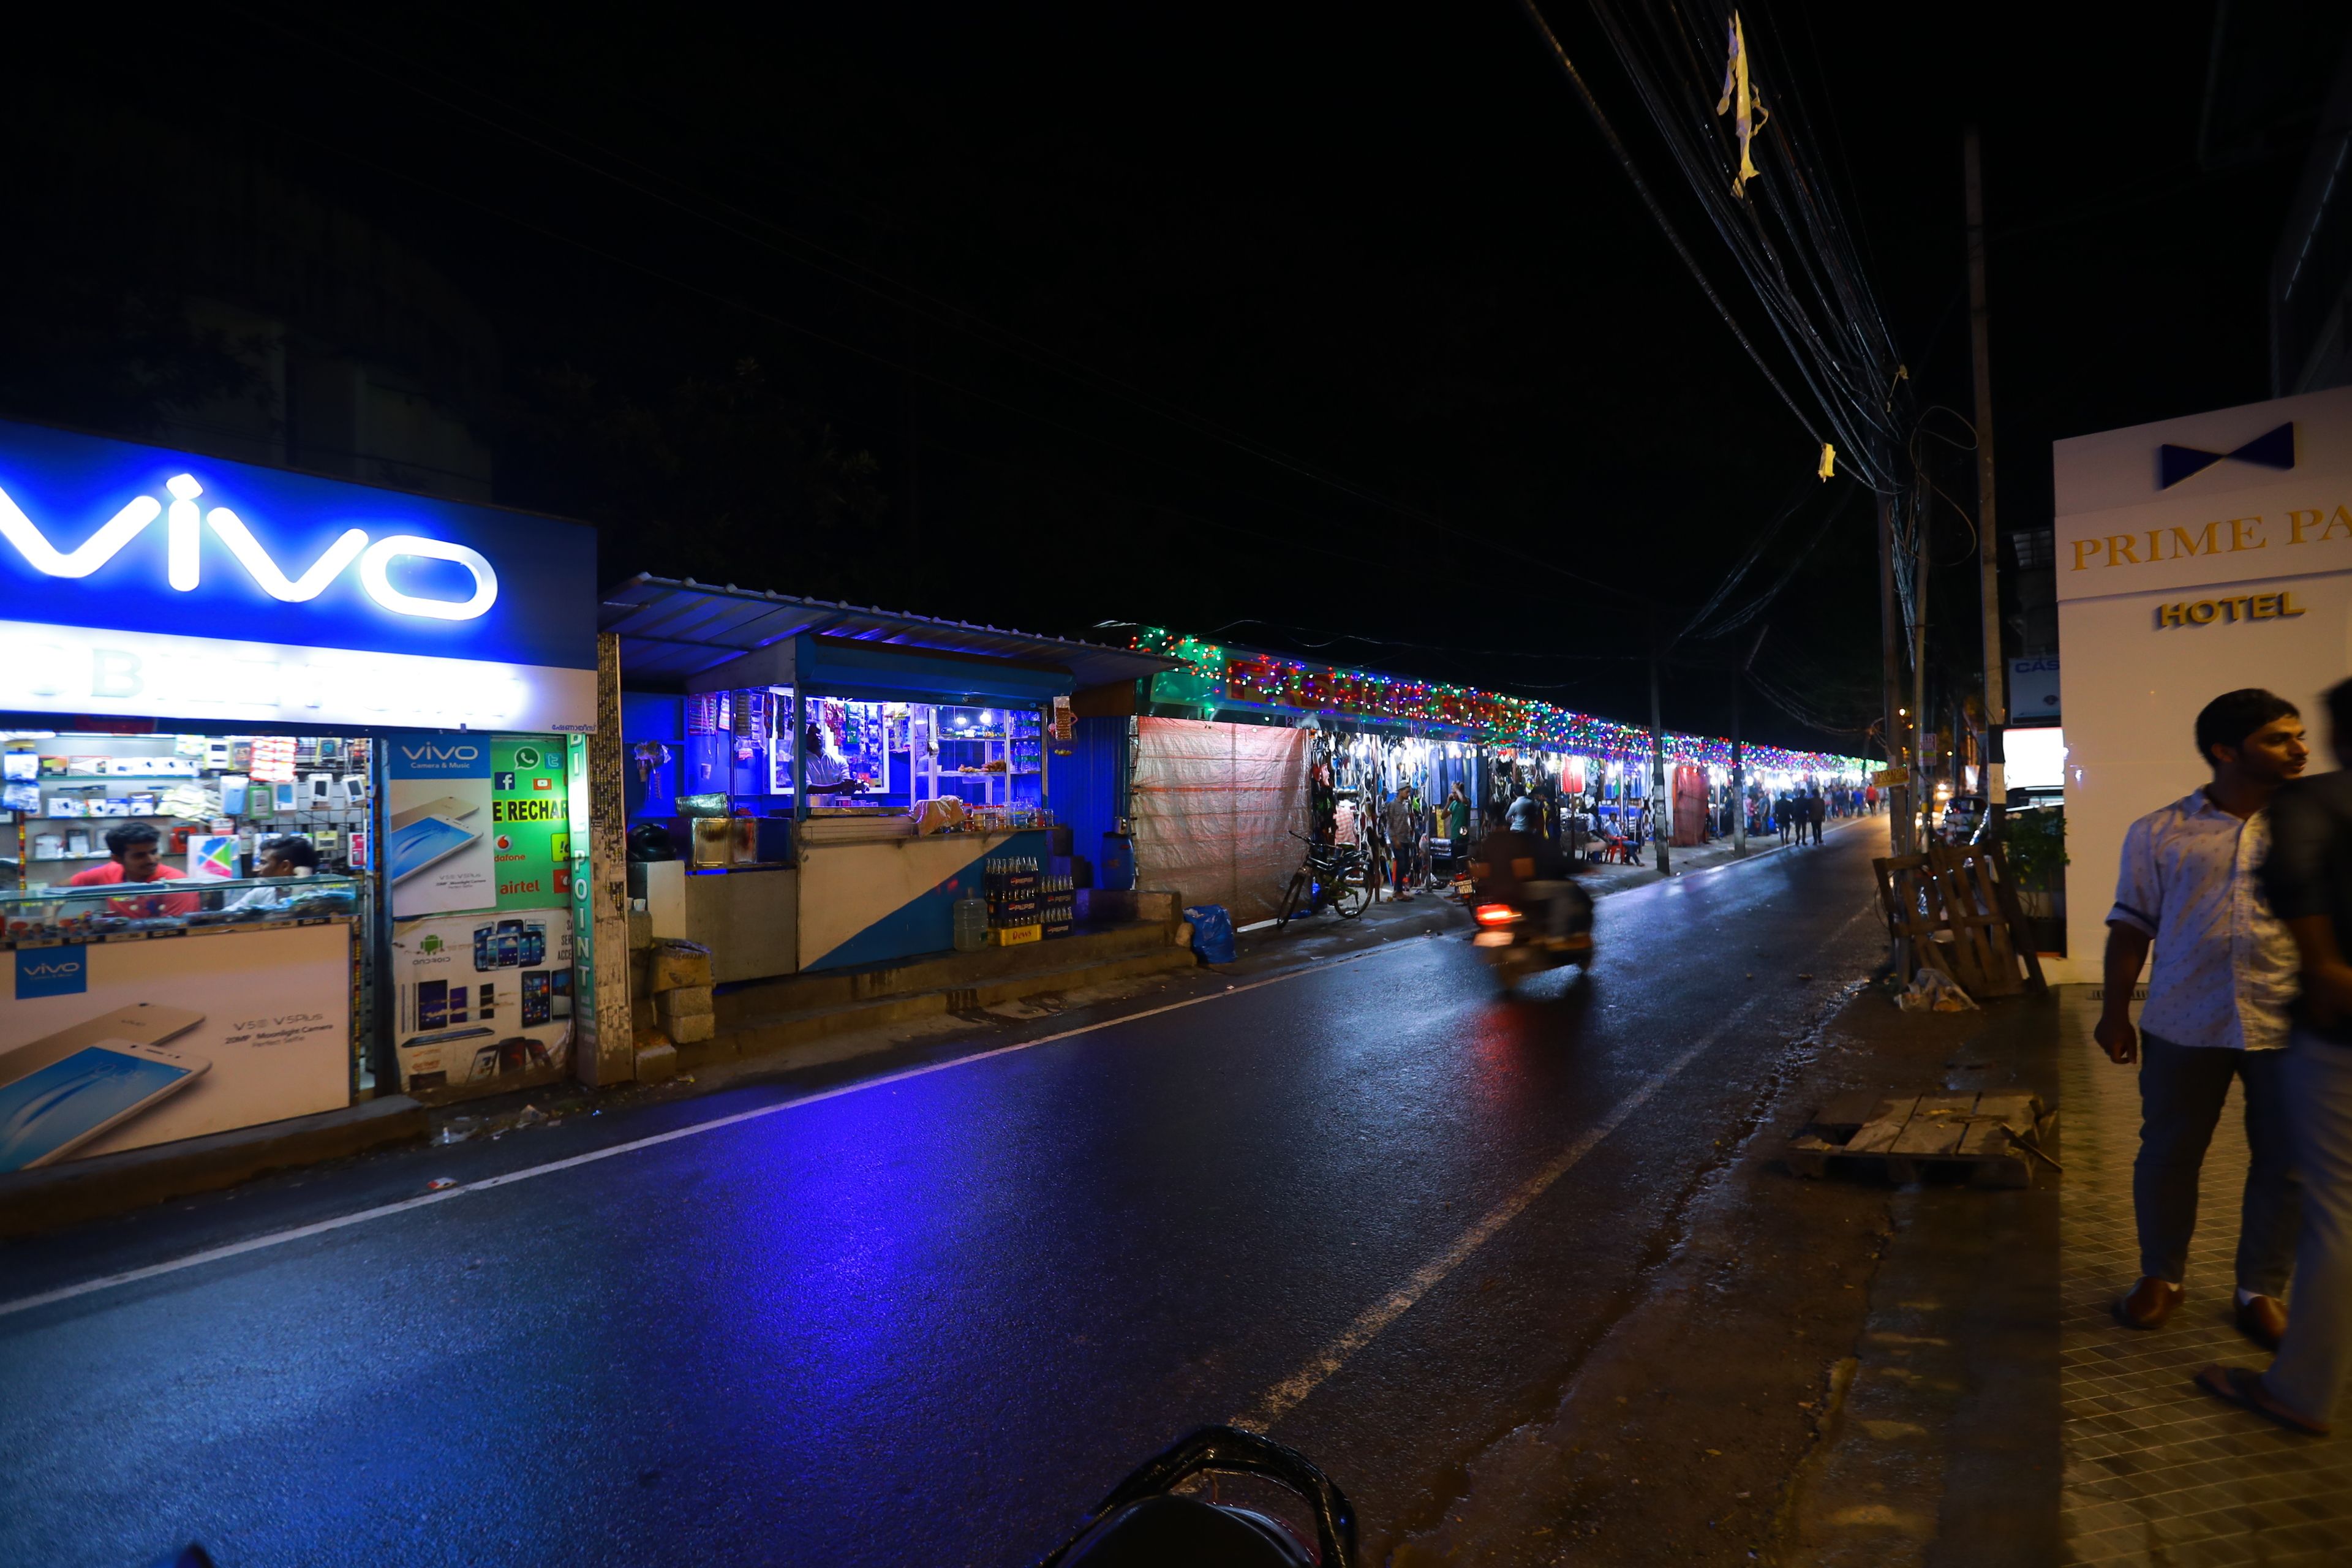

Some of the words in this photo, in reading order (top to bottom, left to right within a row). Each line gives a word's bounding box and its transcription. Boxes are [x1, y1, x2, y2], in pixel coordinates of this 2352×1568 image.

[0, 473, 498, 621] vivo
[2070, 516, 2267, 571] PRIME
[2160, 592, 2306, 627] HOTEL
[2015, 660, 2060, 673] CAS
[402, 741, 478, 760] vivo
[500, 880, 540, 895] airtel
[1014, 902, 1035, 911] PEPSI
[23, 962, 80, 975] vivo
